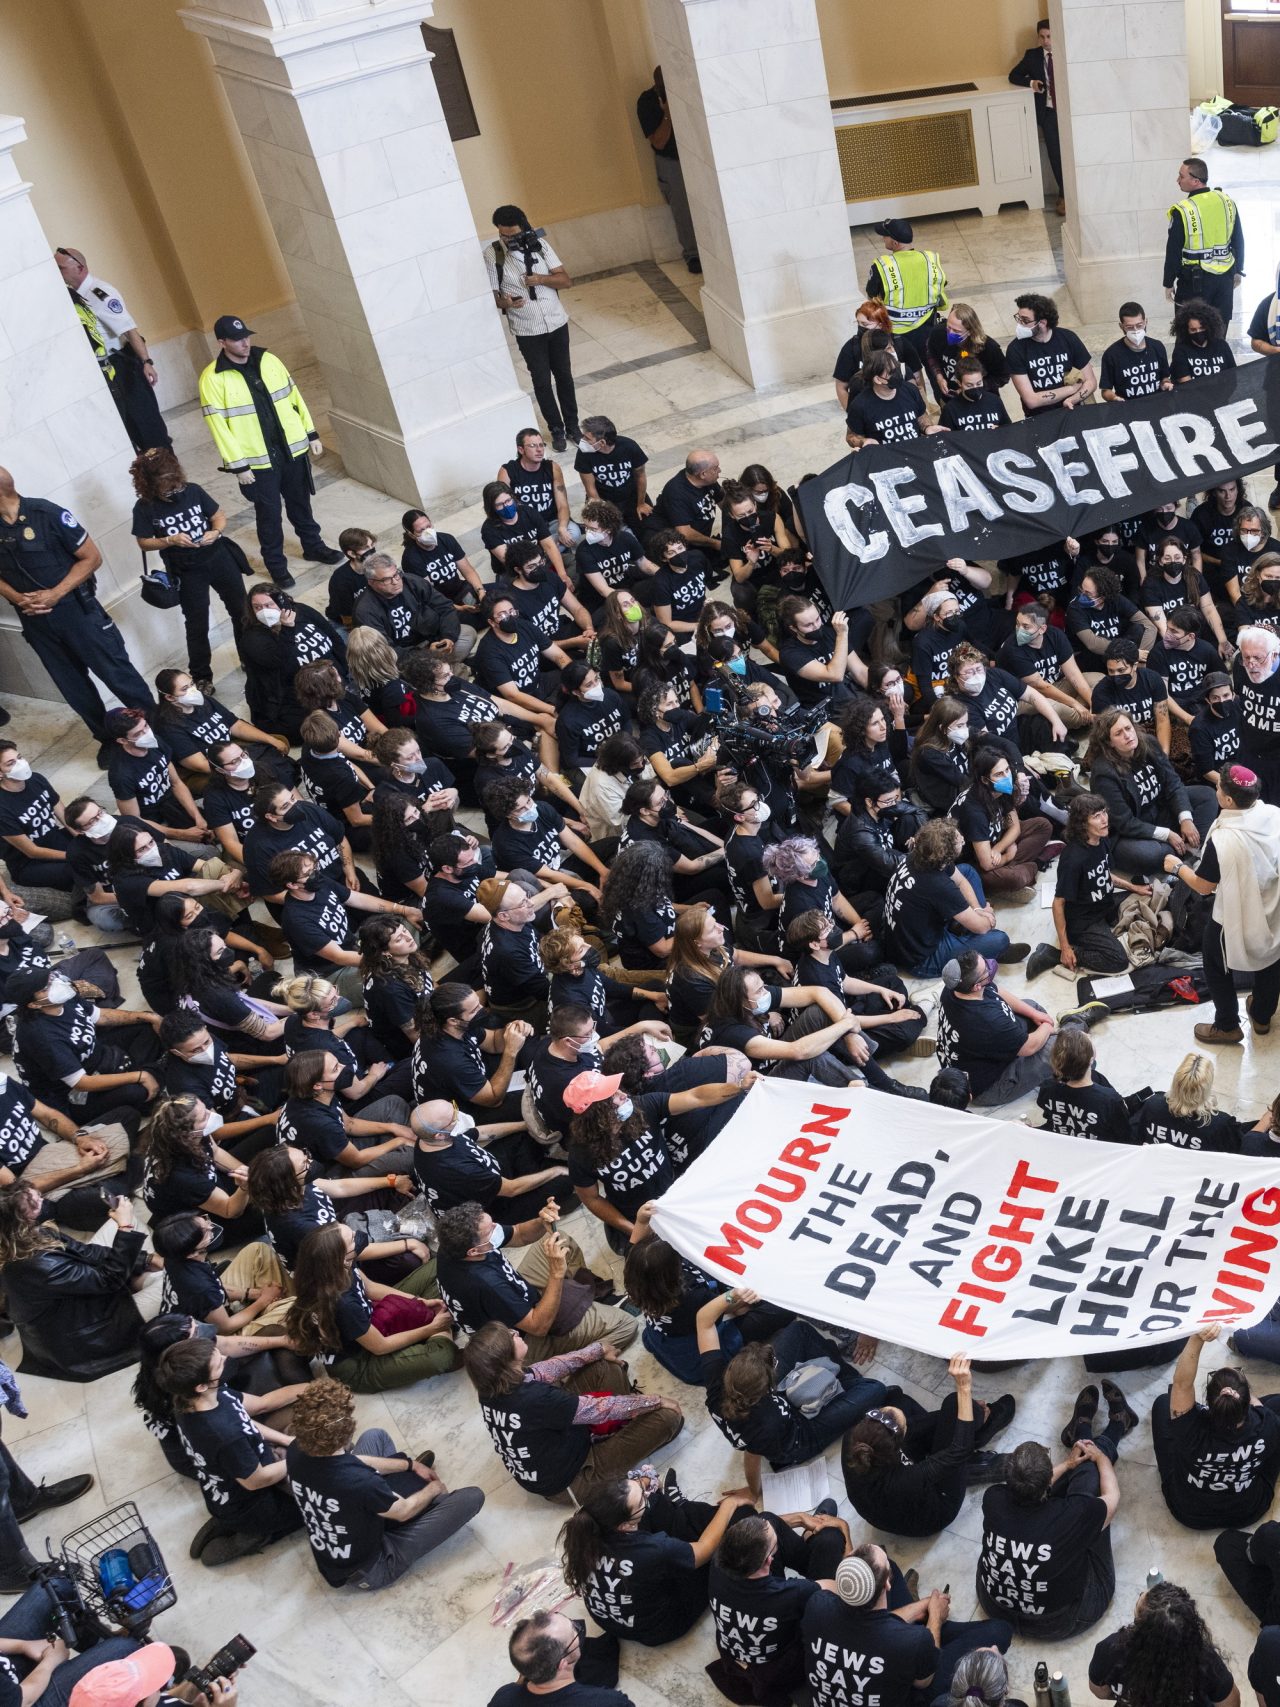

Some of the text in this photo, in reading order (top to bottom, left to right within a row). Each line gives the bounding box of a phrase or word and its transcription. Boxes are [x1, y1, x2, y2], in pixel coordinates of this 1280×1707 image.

[888, 267, 899, 290] USCP
[1029, 357, 1053, 368] NOT
[1037, 364, 1064, 377] OUR
[1122, 367, 1145, 379] NOT
[1130, 372, 1157, 384] OUR
[876, 411, 916, 430] NOT IN
[958, 414, 982, 425] NOT
[885, 423, 914, 438] OUR
[514, 485, 538, 494] NOT
[521, 493, 549, 502] OUR
[188, 504, 201, 517] IN
[167, 515, 202, 535] OUR
[430, 562, 457, 581] OUR
[1022, 563, 1038, 575] NOT
[1028, 571, 1058, 586] OUR
[673, 584, 689, 599] NOT
[532, 596, 559, 627] JEWS
[1163, 598, 1184, 611] NOT
[306, 624, 315, 634] IN
[1254, 615, 1278, 627] NOT
[297, 632, 324, 652] OUR
[511, 645, 539, 672] NOT IN
[933, 650, 952, 662] NOT
[518, 659, 539, 679] OUR
[1196, 663, 1207, 673] IN
[984, 688, 1008, 718] NOT IN
[1242, 685, 1265, 704] NOT
[209, 712, 222, 724] IN
[458, 694, 484, 722] NOT IN
[469, 701, 488, 722] OUR
[995, 698, 1016, 721] OUR
[1245, 699, 1276, 720] OUR
[583, 708, 621, 735] NOT IN
[596, 721, 622, 742] OUR
[204, 724, 229, 744] OUR
[1214, 728, 1236, 747] NOT
[138, 767, 157, 788] NOT
[19, 790, 50, 824] NOT IN
[309, 828, 324, 844] IN
[546, 828, 558, 844] IN
[167, 868, 181, 882] IN
[318, 890, 338, 929] NOT IN
[330, 906, 346, 933] OUR
[70, 1003, 85, 1045] NOT IN
[212, 1051, 230, 1096] NOT IN
[222, 1063, 236, 1101] OUR
[1047, 1098, 1098, 1124] JEWS
[1053, 1114, 1091, 1131] SAY
[8, 1119, 31, 1155] OUR
[1146, 1123, 1202, 1150] JEWS
[598, 1132, 653, 1177] NOT IN
[613, 1147, 654, 1183] OUR
[613, 1151, 665, 1192] NAME
[703, 1102, 851, 1275] MOURN
[789, 1163, 873, 1245] THE
[823, 1149, 950, 1301] DEAD,
[909, 1191, 983, 1288] AND
[938, 1159, 1060, 1338] FIGHT
[1011, 1195, 1110, 1326] LIKE
[1069, 1196, 1175, 1338] HELL
[1127, 1177, 1241, 1339] OR THE
[1197, 1438, 1266, 1464] JEWS
[1187, 1472, 1252, 1493] NOW
[986, 1531, 1052, 1562] JEWS
[988, 1551, 1039, 1580] SAY
[710, 1597, 778, 1632] JEWS
[718, 1618, 767, 1646] SAY
[810, 1637, 885, 1675] JEWS
[815, 1660, 872, 1693] SAY
